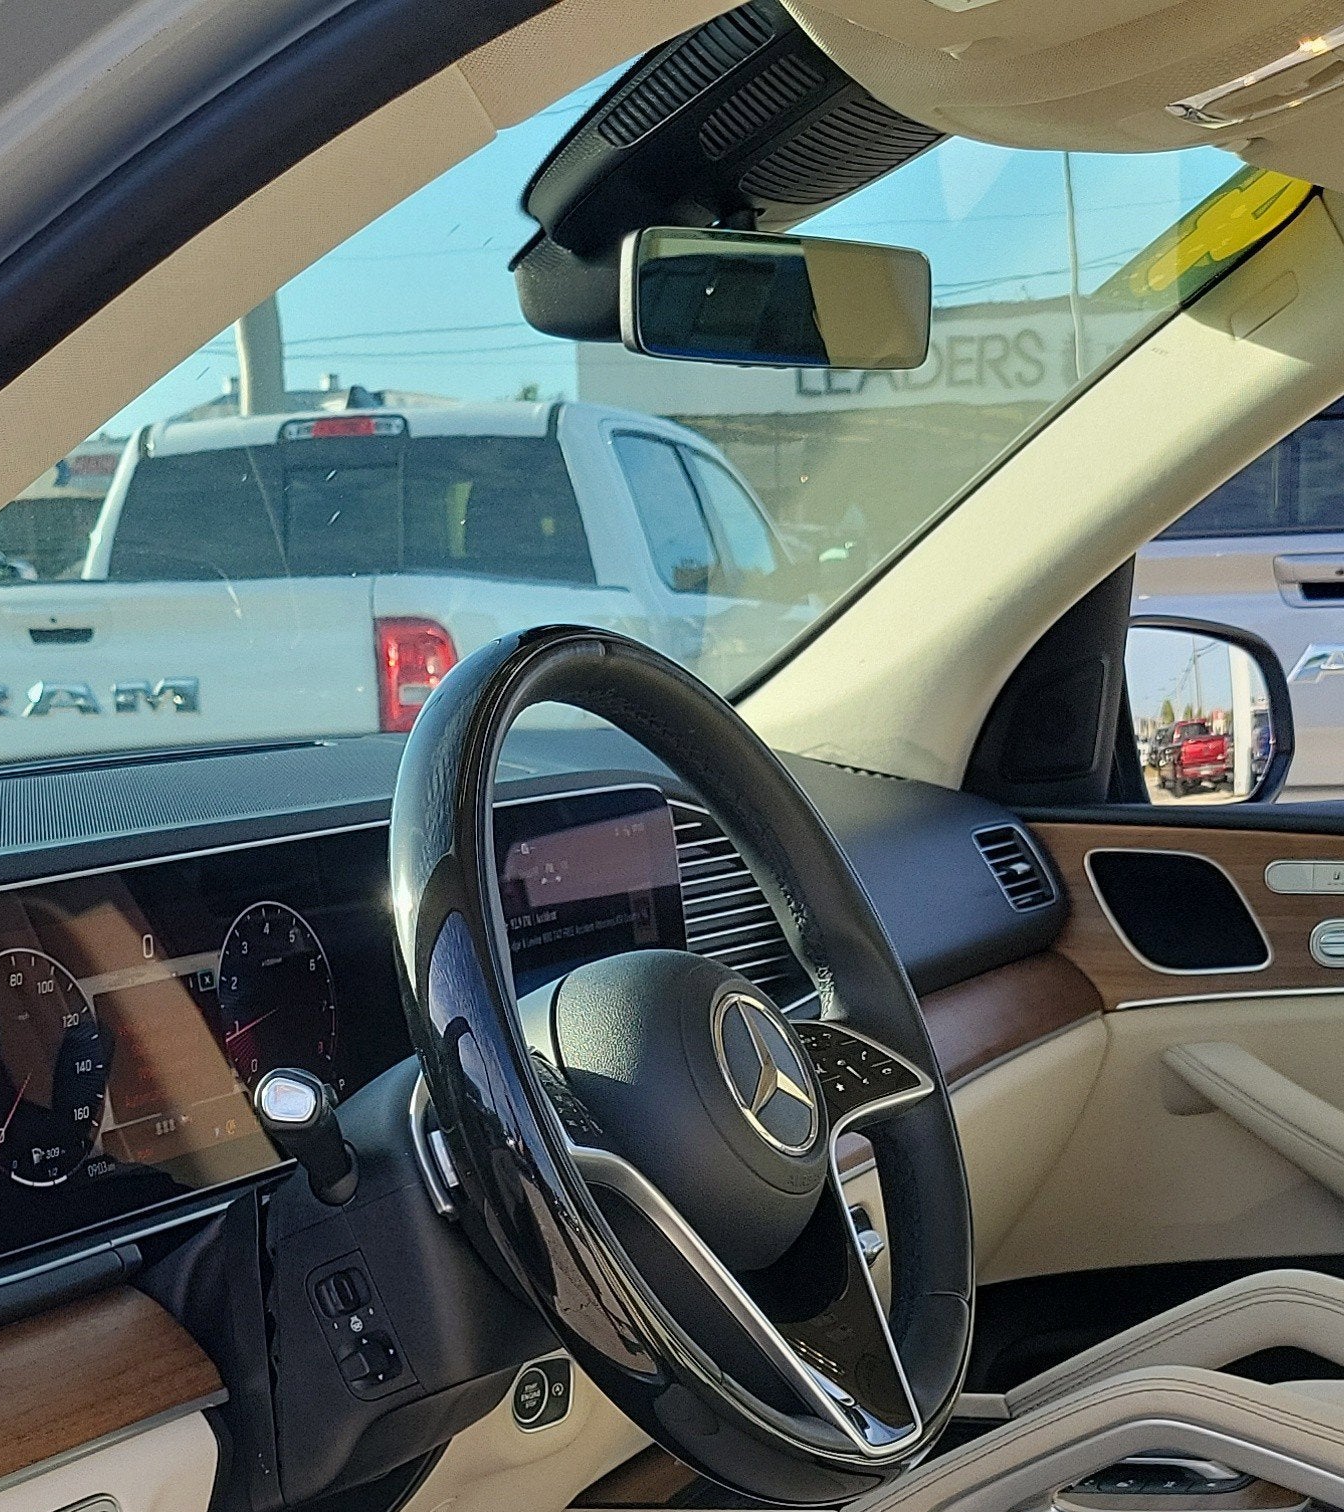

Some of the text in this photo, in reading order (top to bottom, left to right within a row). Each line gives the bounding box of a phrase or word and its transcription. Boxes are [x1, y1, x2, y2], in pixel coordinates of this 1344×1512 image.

[263, 922, 270, 935] 4
[142, 933, 154, 959] 0
[241, 941, 248, 954] 3
[309, 958, 316, 971] 6
[9, 973, 23, 987] 80
[37, 980, 54, 994] 100
[231, 976, 238, 990] 2
[62, 1013, 79, 1029] 120
[75, 1059, 92, 1074] 140
[73, 1105, 90, 1121] 160
